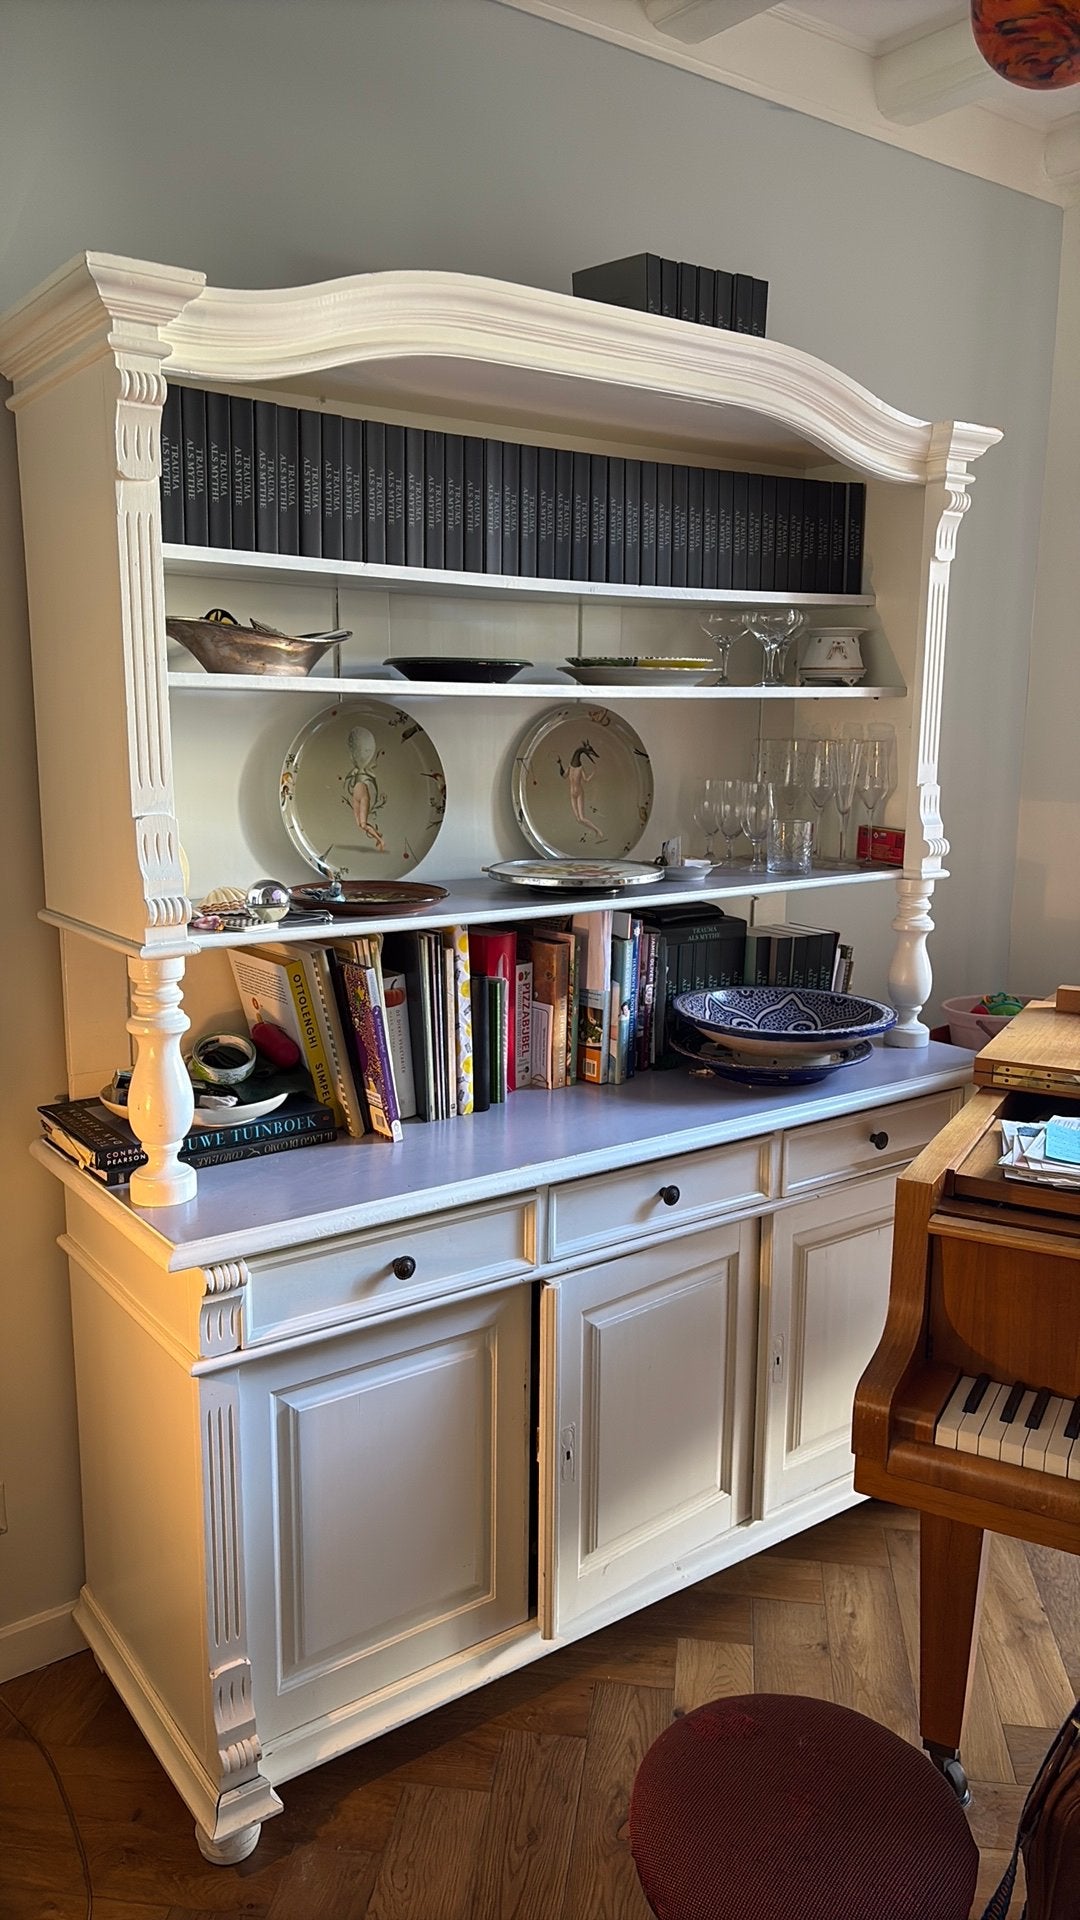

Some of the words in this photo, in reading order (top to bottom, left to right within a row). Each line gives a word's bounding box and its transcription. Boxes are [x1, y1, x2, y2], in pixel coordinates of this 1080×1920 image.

[162, 434, 170, 455] ALS
[163, 458, 171, 496] MYTHE
[171, 444, 180, 490] TRAUMA
[293, 974, 318, 1050] OTTOLENGHI
[315, 1062, 332, 1104] SIMPEL
[231, 1115, 319, 1142] TUINBOEK
[264, 1142, 288, 1153] COMO
[300, 1134, 323, 1146] LAGO
[106, 1146, 142, 1159] CONRA
[106, 1154, 146, 1166] PEARSON
